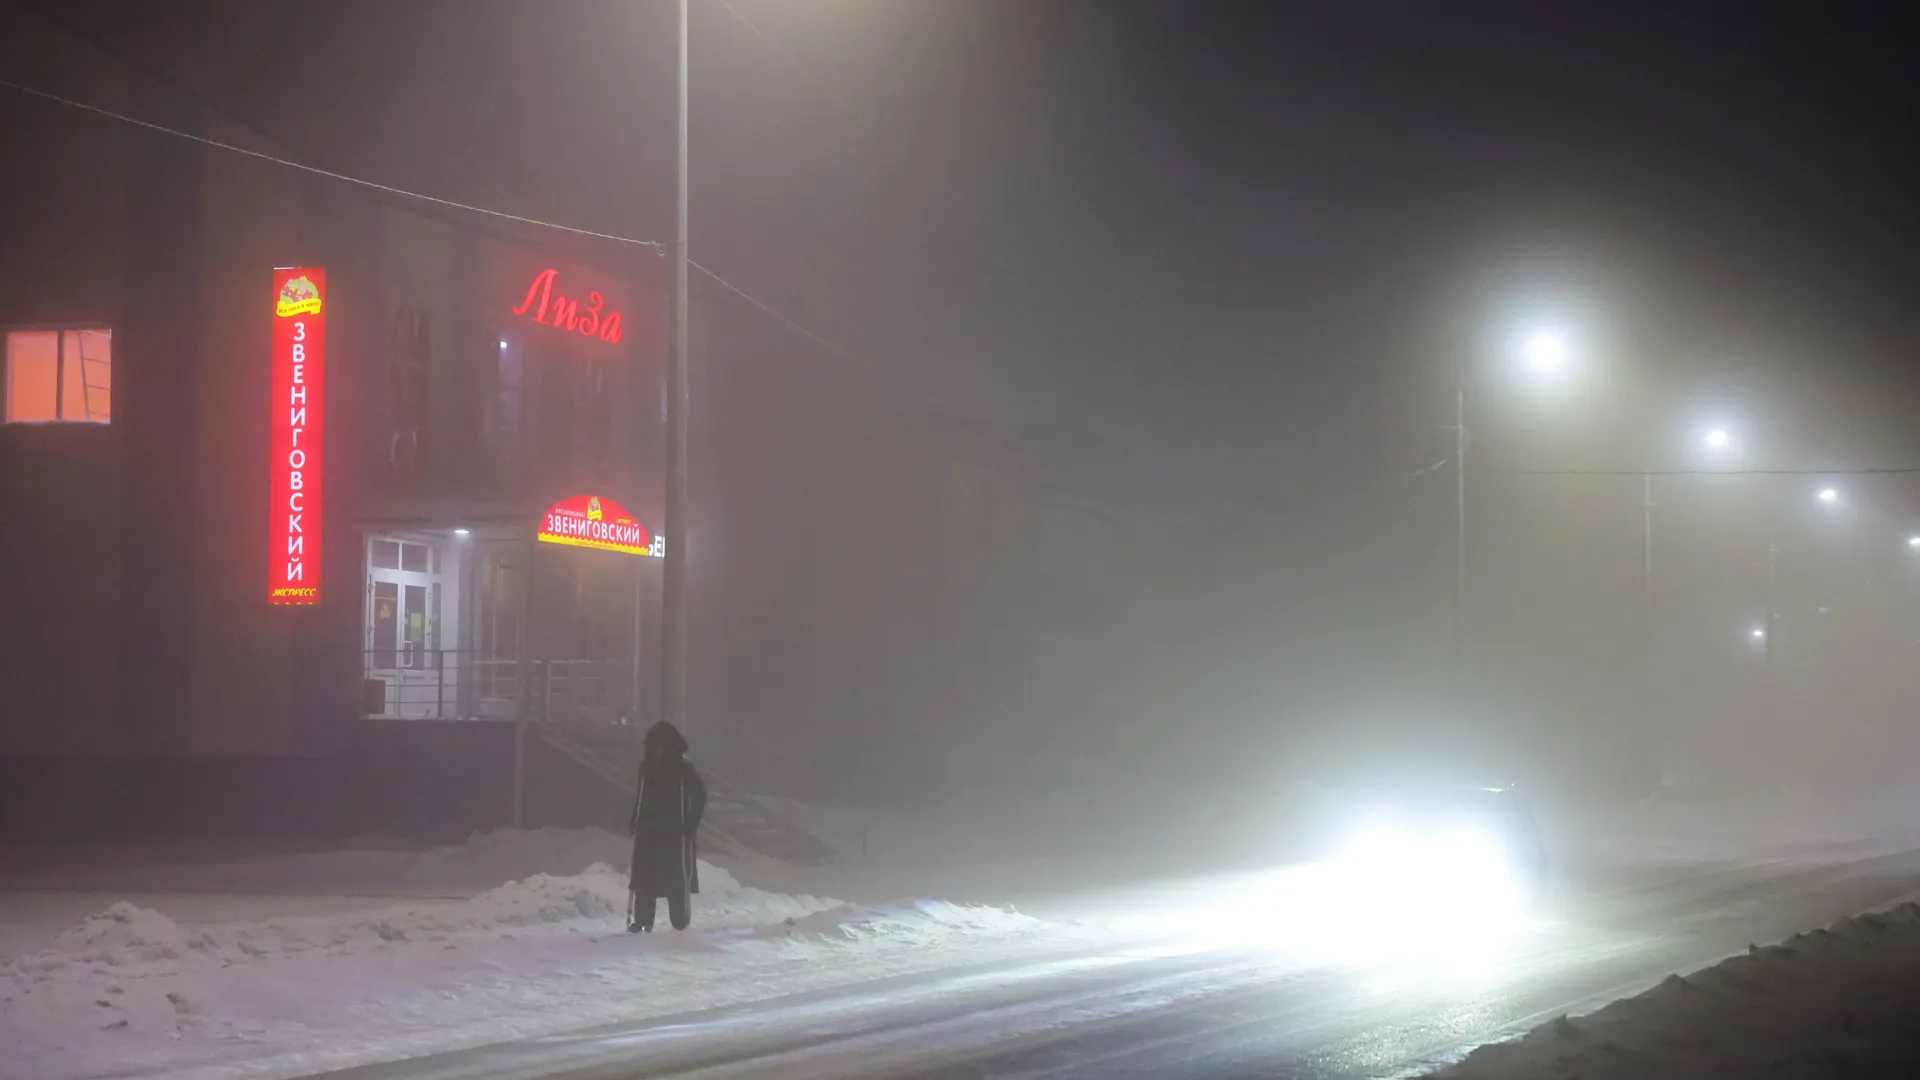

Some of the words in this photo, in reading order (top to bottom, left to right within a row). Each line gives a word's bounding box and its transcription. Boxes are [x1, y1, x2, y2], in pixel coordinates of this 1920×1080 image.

[287, 321, 306, 582] ЗВЕНИГОВСКИЙ
[547, 513, 640, 544] ЗВЕНИГОВСКИЙ
[271, 587, 317, 597] ЭКСПРЕСС
